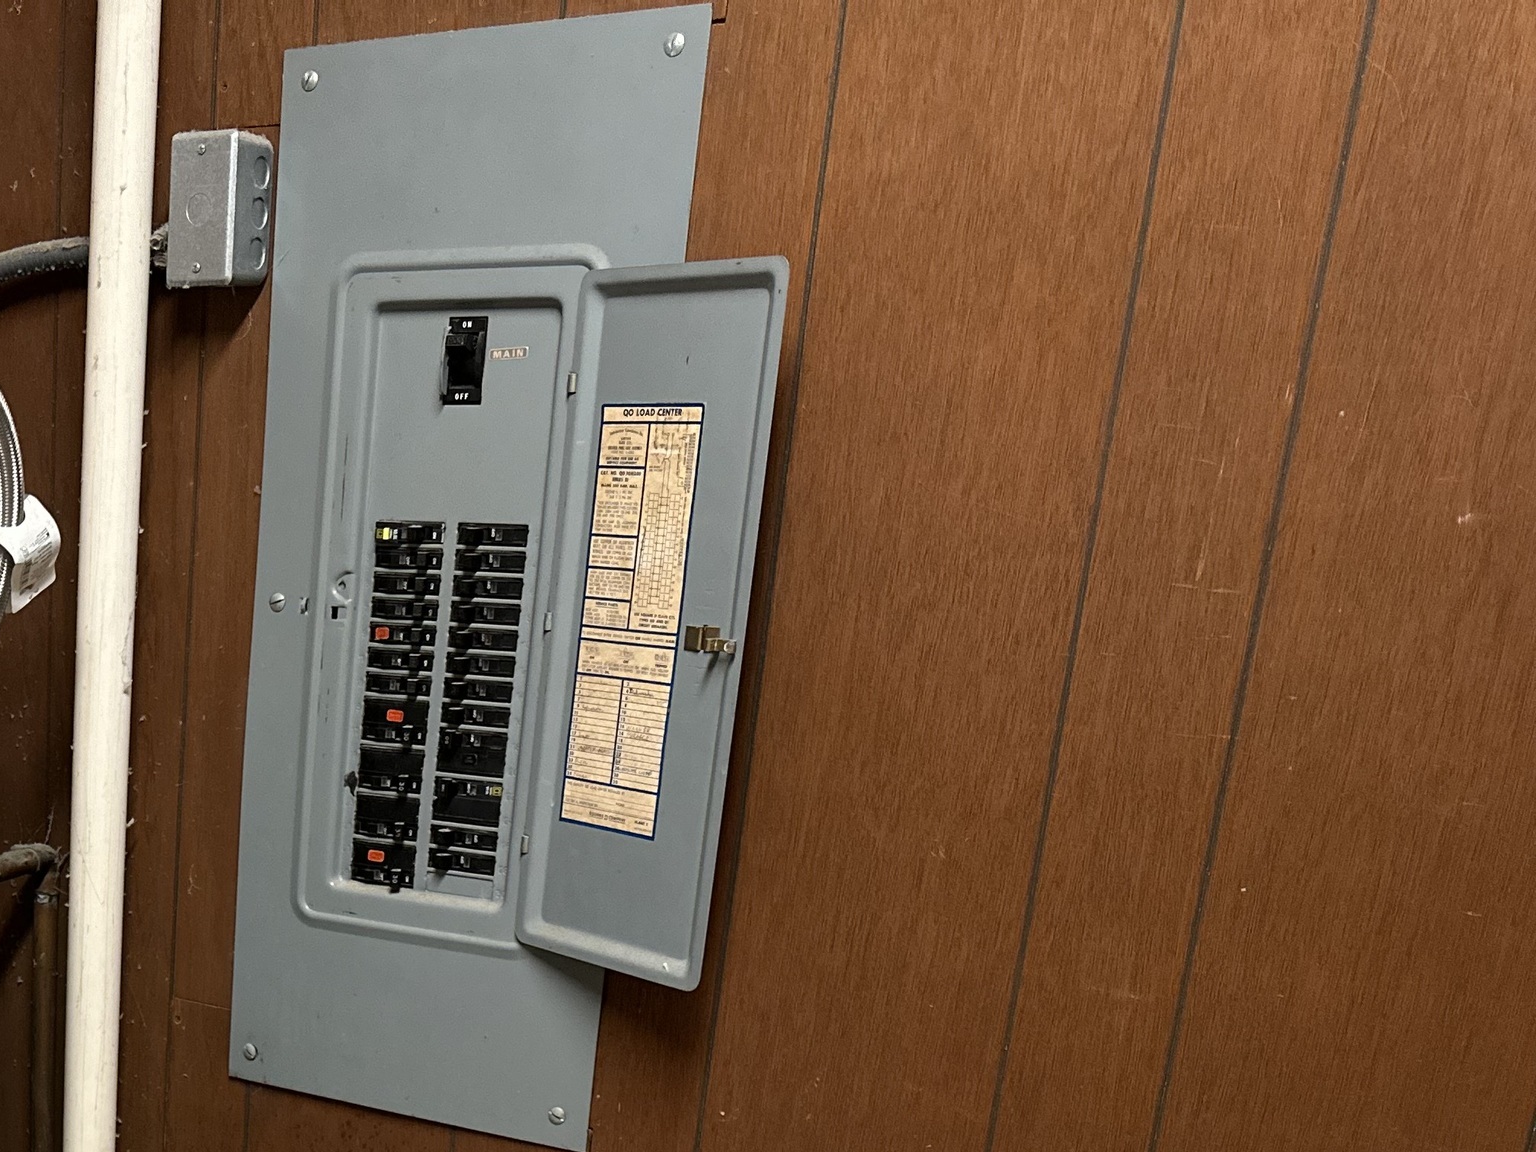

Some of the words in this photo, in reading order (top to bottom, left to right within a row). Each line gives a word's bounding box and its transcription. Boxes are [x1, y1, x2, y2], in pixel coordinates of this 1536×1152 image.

[492, 349, 524, 358] MAIN
[454, 392, 469, 400] OFF
[623, 408, 634, 417] QO
[636, 408, 655, 416] LOAD
[657, 408, 682, 416] CENTER
